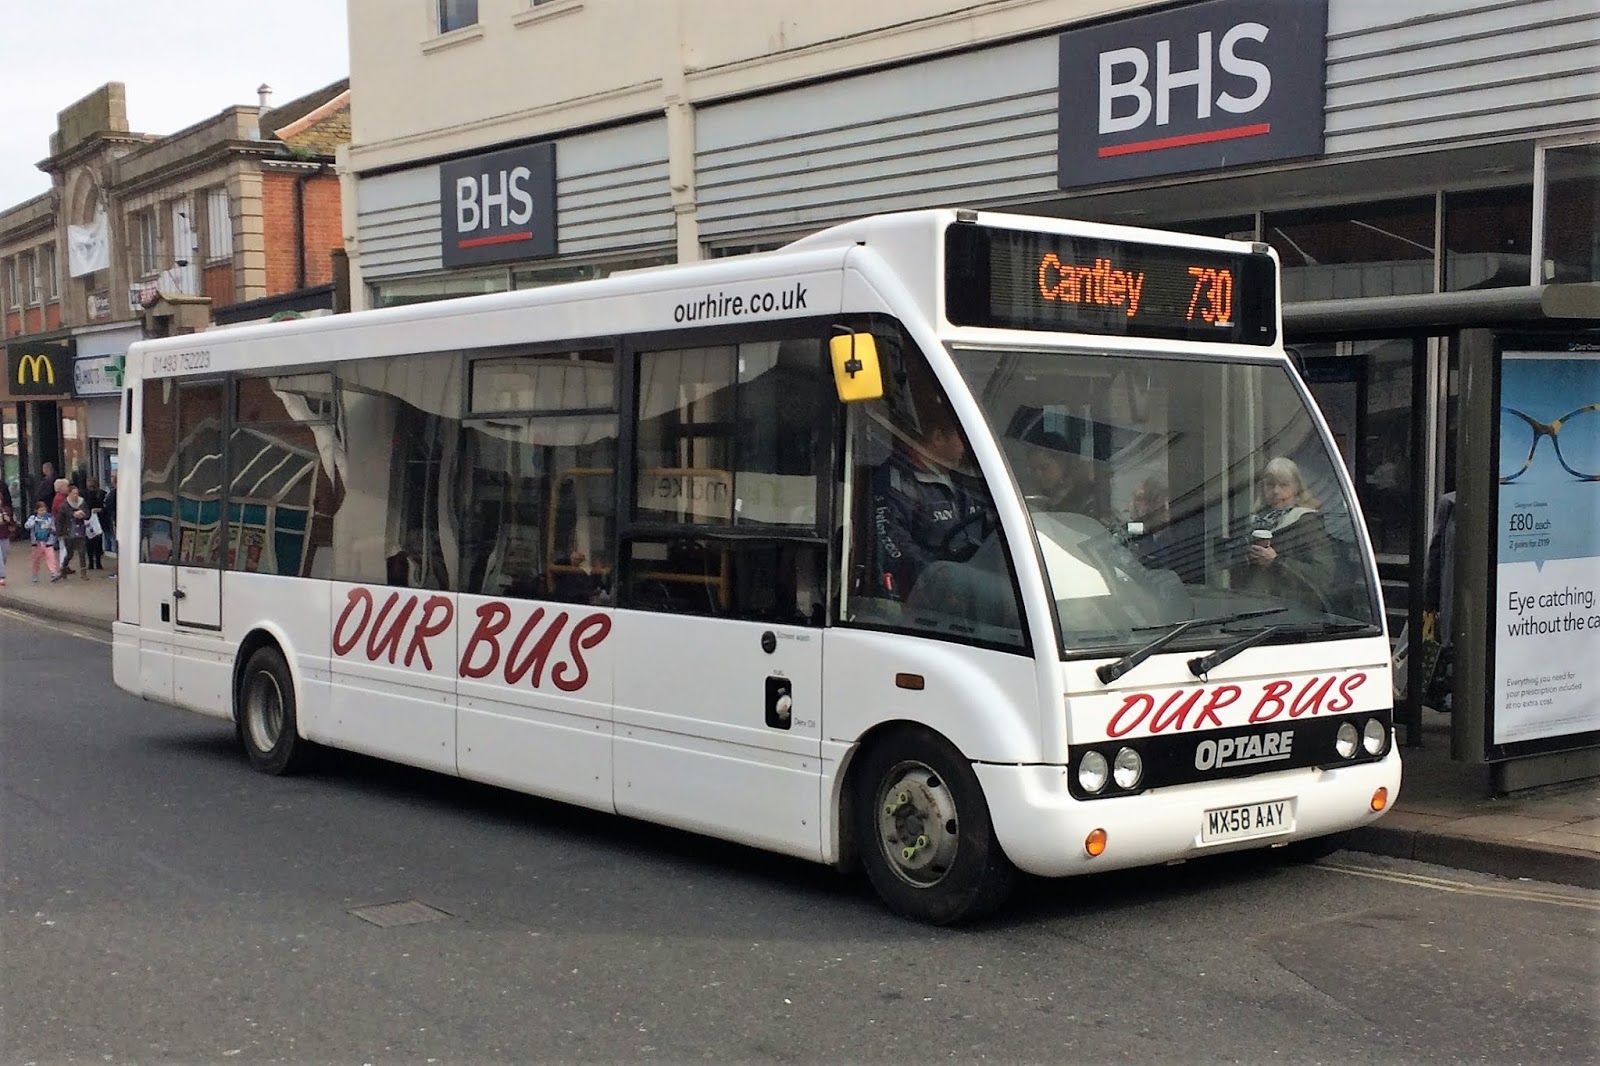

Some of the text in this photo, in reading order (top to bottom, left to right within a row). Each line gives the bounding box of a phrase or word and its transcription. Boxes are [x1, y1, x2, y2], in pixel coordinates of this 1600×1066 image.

[1098, 22, 1272, 135] BHS
[456, 167, 533, 233] BHS
[1038, 253, 1144, 317] Cantley
[1186, 266, 1233, 323] 730
[674, 283, 808, 323] ourhire.co.uk
[153, 350, 210, 374] 01493 752223
[1509, 513, 1551, 531] £80 each
[1509, 540, 1514, 549] 2
[1529, 539, 1537, 548] for
[1509, 586, 1596, 615] Eye catching,
[332, 587, 612, 692] OUR BUS
[1508, 616, 1561, 637] without
[1563, 612, 1584, 632] the
[1505, 682, 1582, 700] your prescription included
[1506, 671, 1576, 688] Everything you need for
[1106, 672, 1367, 738] OUR BUS
[1505, 701, 1512, 710] at
[1522, 700, 1538, 708] extra
[1194, 730, 1294, 771] OPTARE
[1209, 802, 1285, 835] MX58 AAY
